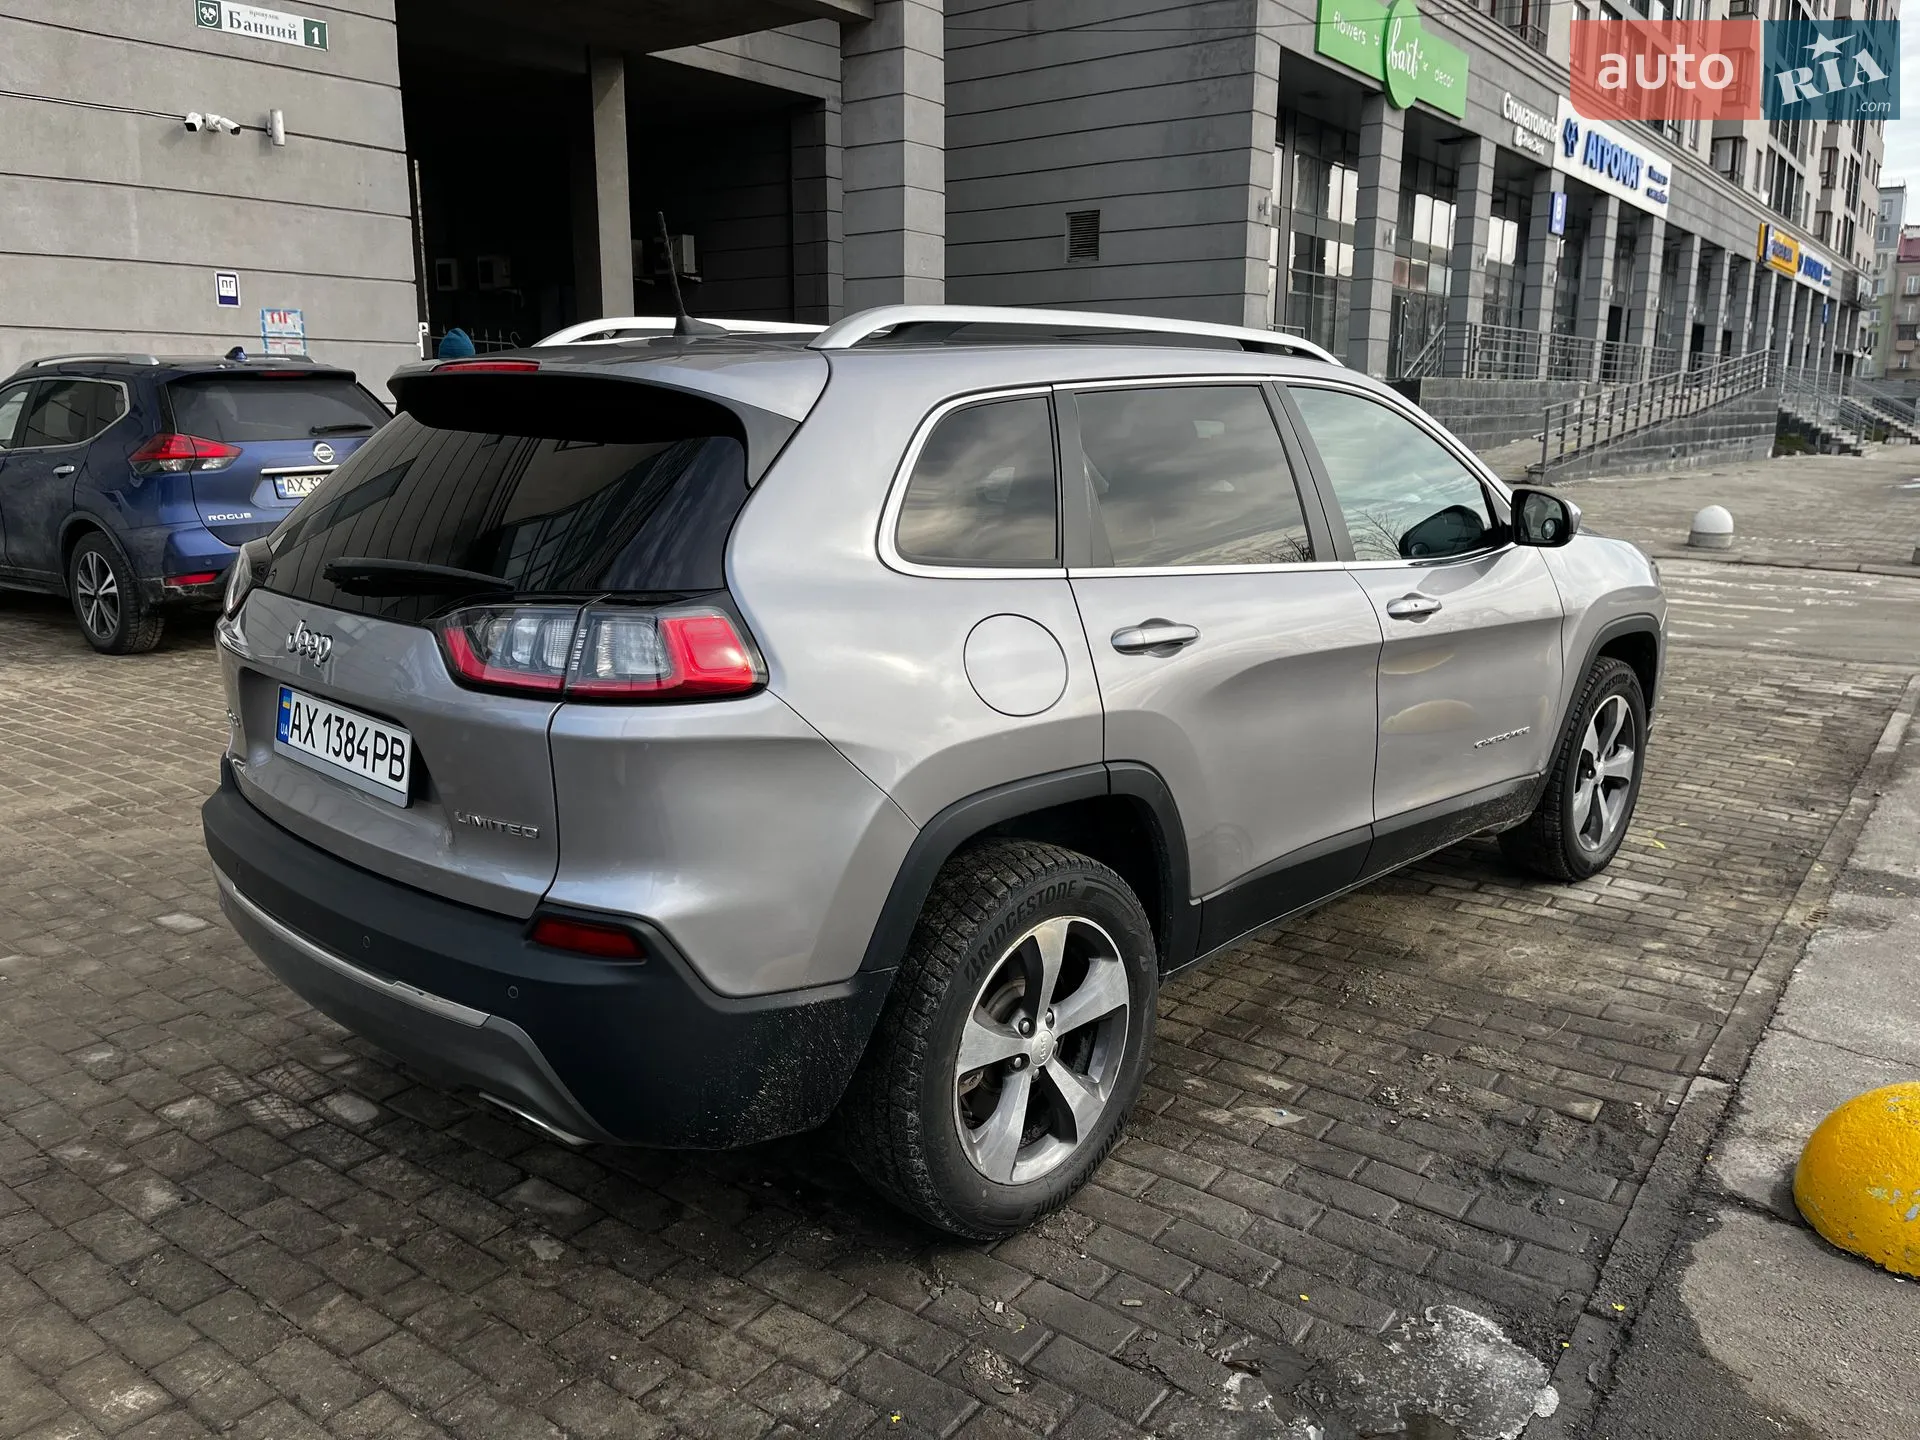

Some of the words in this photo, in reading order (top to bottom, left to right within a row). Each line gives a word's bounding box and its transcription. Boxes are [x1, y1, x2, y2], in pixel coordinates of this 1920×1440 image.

[228, 10, 298, 41] Банний
[311, 26, 321, 45] 1
[1333, 11, 1367, 45] flowers
[1583, 130, 1645, 191] АГРОМАТ
[208, 512, 252, 521] ROGUE
[285, 618, 334, 667] Jeep
[280, 722, 289, 738] UA
[454, 810, 540, 839] LIMITED
[963, 878, 1079, 983] BRIDGESTONE
